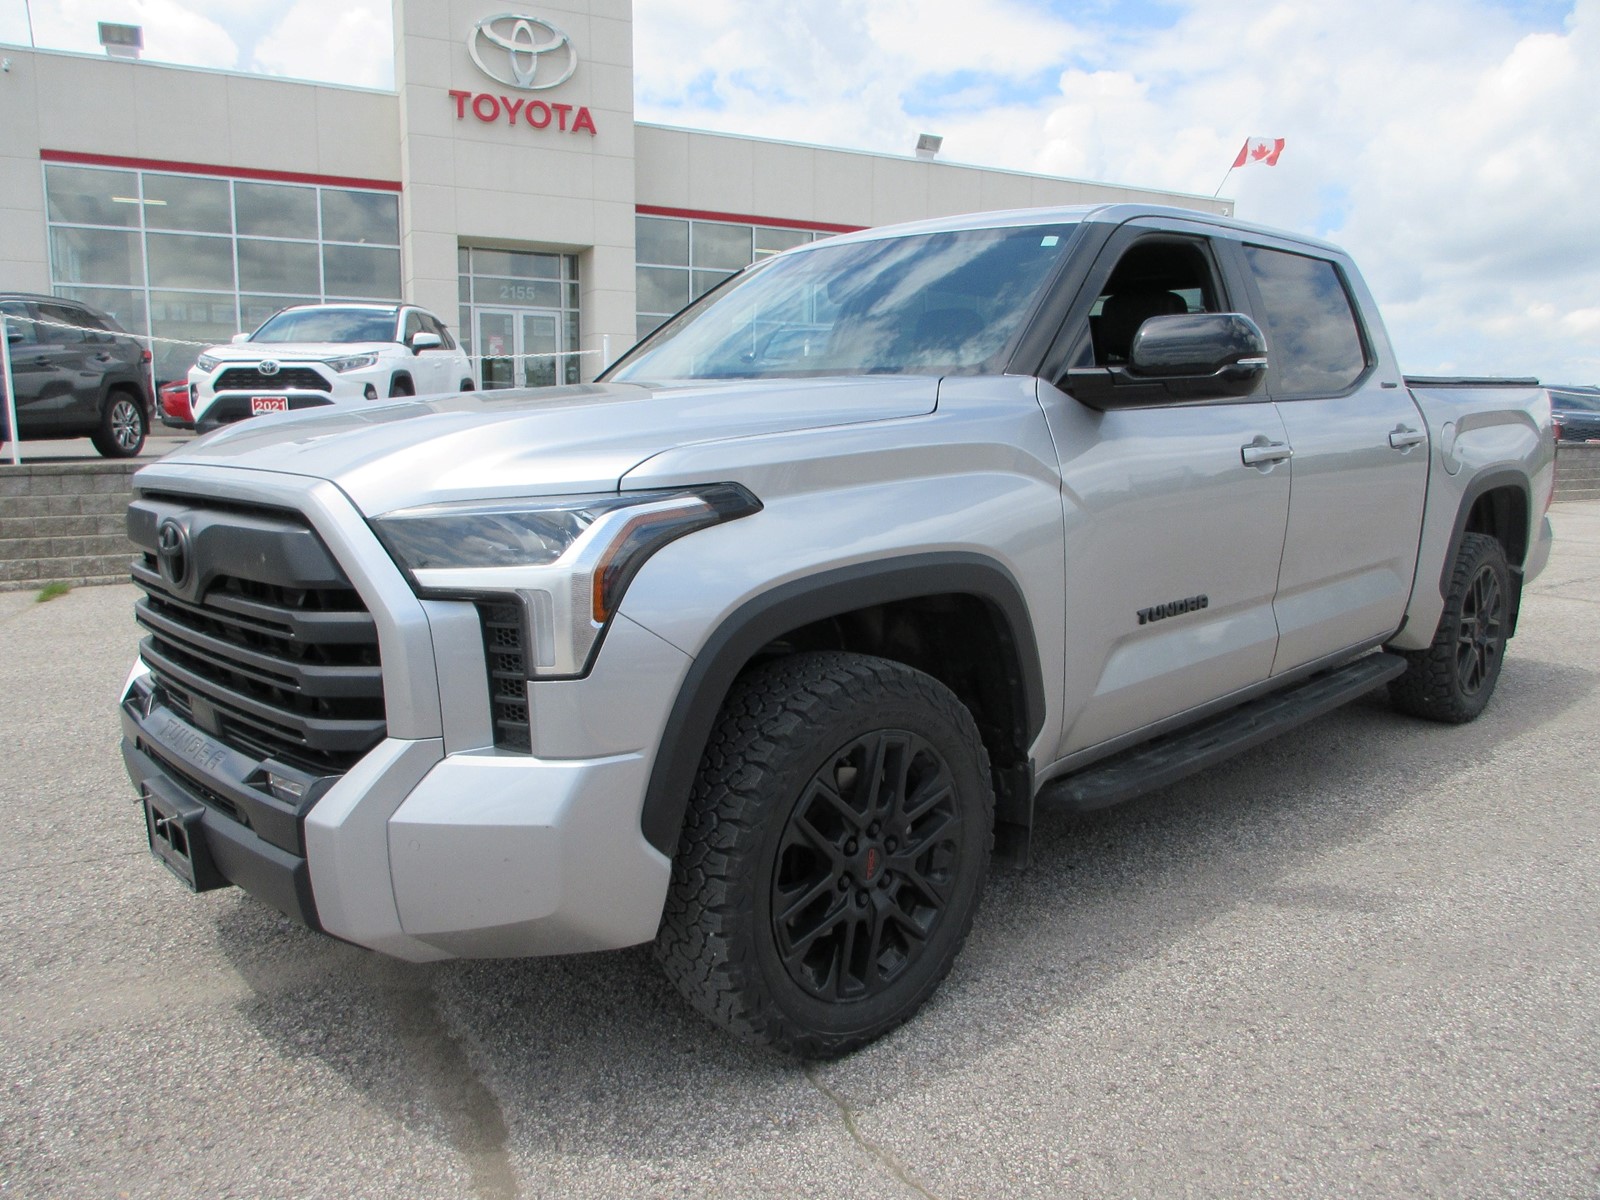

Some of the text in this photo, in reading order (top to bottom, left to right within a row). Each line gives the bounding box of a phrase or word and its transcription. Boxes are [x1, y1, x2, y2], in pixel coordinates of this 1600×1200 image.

[448, 89, 598, 136] TOYOTA
[500, 285, 536, 300] 2155
[255, 400, 286, 411] 2021
[1136, 594, 1209, 625] TUNDRA
